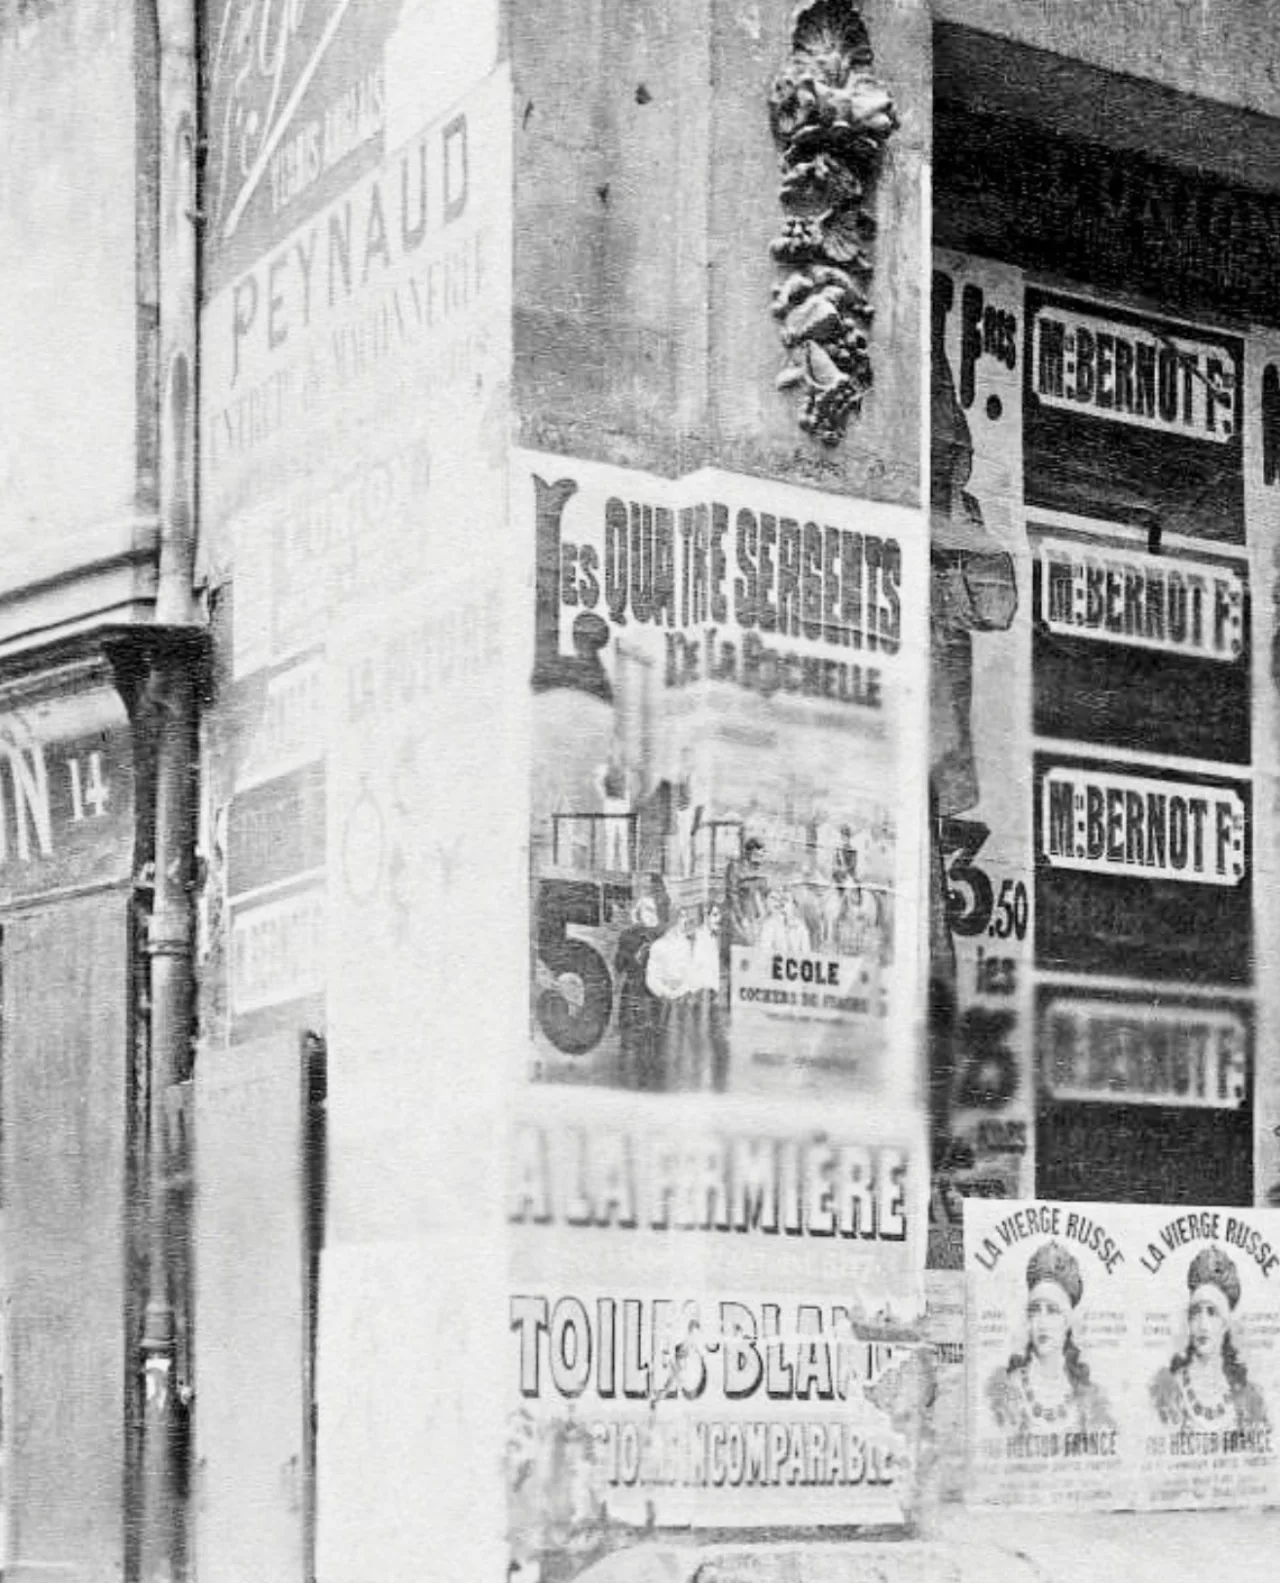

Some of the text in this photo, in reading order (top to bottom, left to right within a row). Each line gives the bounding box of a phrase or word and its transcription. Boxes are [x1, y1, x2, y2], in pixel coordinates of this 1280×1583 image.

[231, 111, 468, 390] PEYNAUD
[1076, 327, 1199, 427] BERNOT
[605, 497, 728, 628] QUATRE
[734, 507, 901, 655] SERGENTS
[66, 752, 109, 821] 14
[1086, 784, 1208, 874] BERNOT
[772, 954, 840, 985] ÉCOLE
[974, 1205, 1125, 1275] LA VIERGE RUSSE
[1140, 1211, 1280, 1278] LA VIERGE RUSSE
